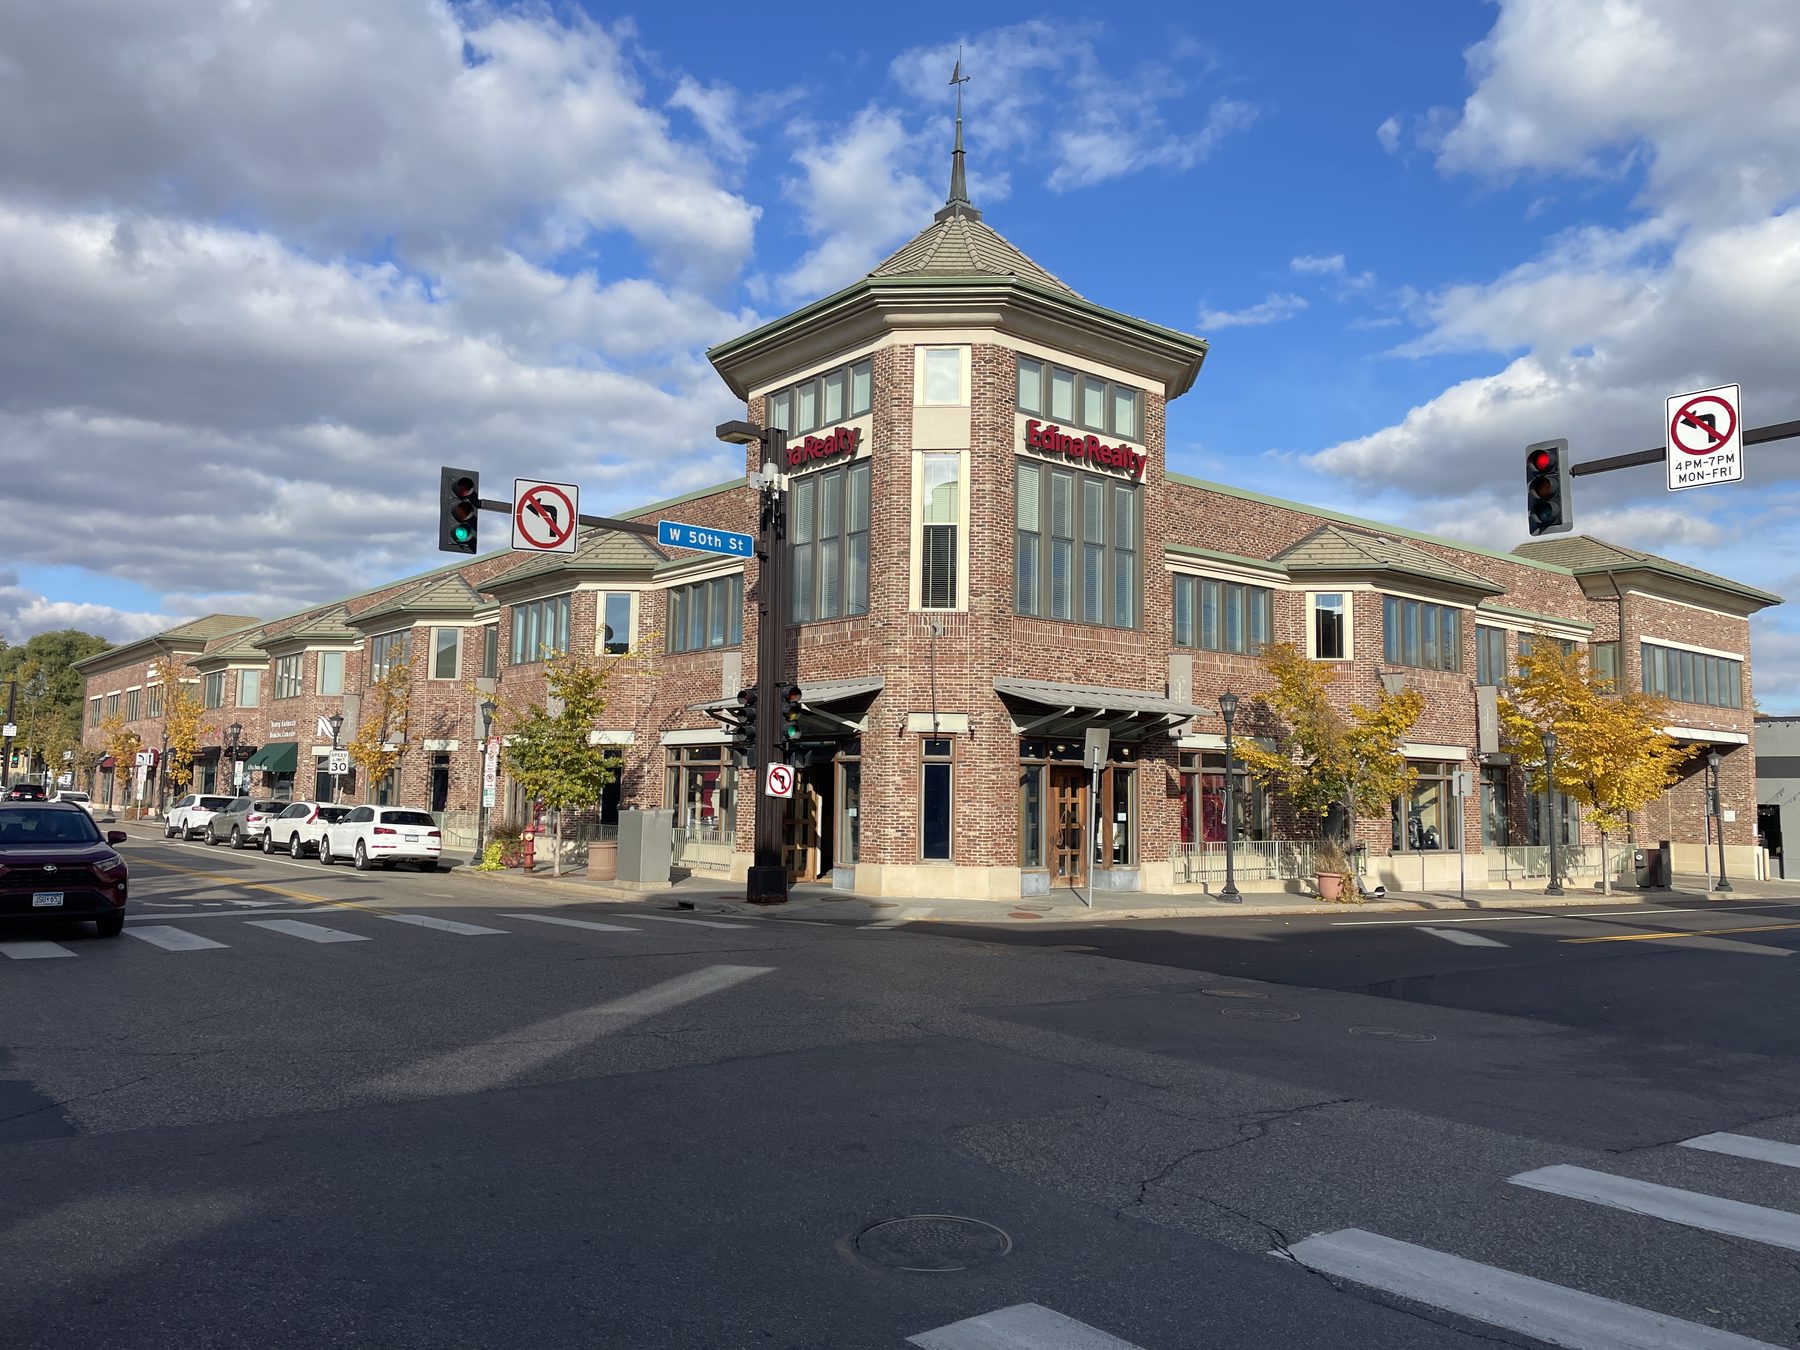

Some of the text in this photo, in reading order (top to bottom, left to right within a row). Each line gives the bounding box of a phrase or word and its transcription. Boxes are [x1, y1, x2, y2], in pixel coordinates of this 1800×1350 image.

[1026, 419, 1147, 478] Edina Realty
[1675, 453, 1735, 471] 4PM-7PM
[1678, 466, 1731, 483] MON-FRI
[669, 527, 744, 551] W 50th St
[331, 762, 347, 772] 30
